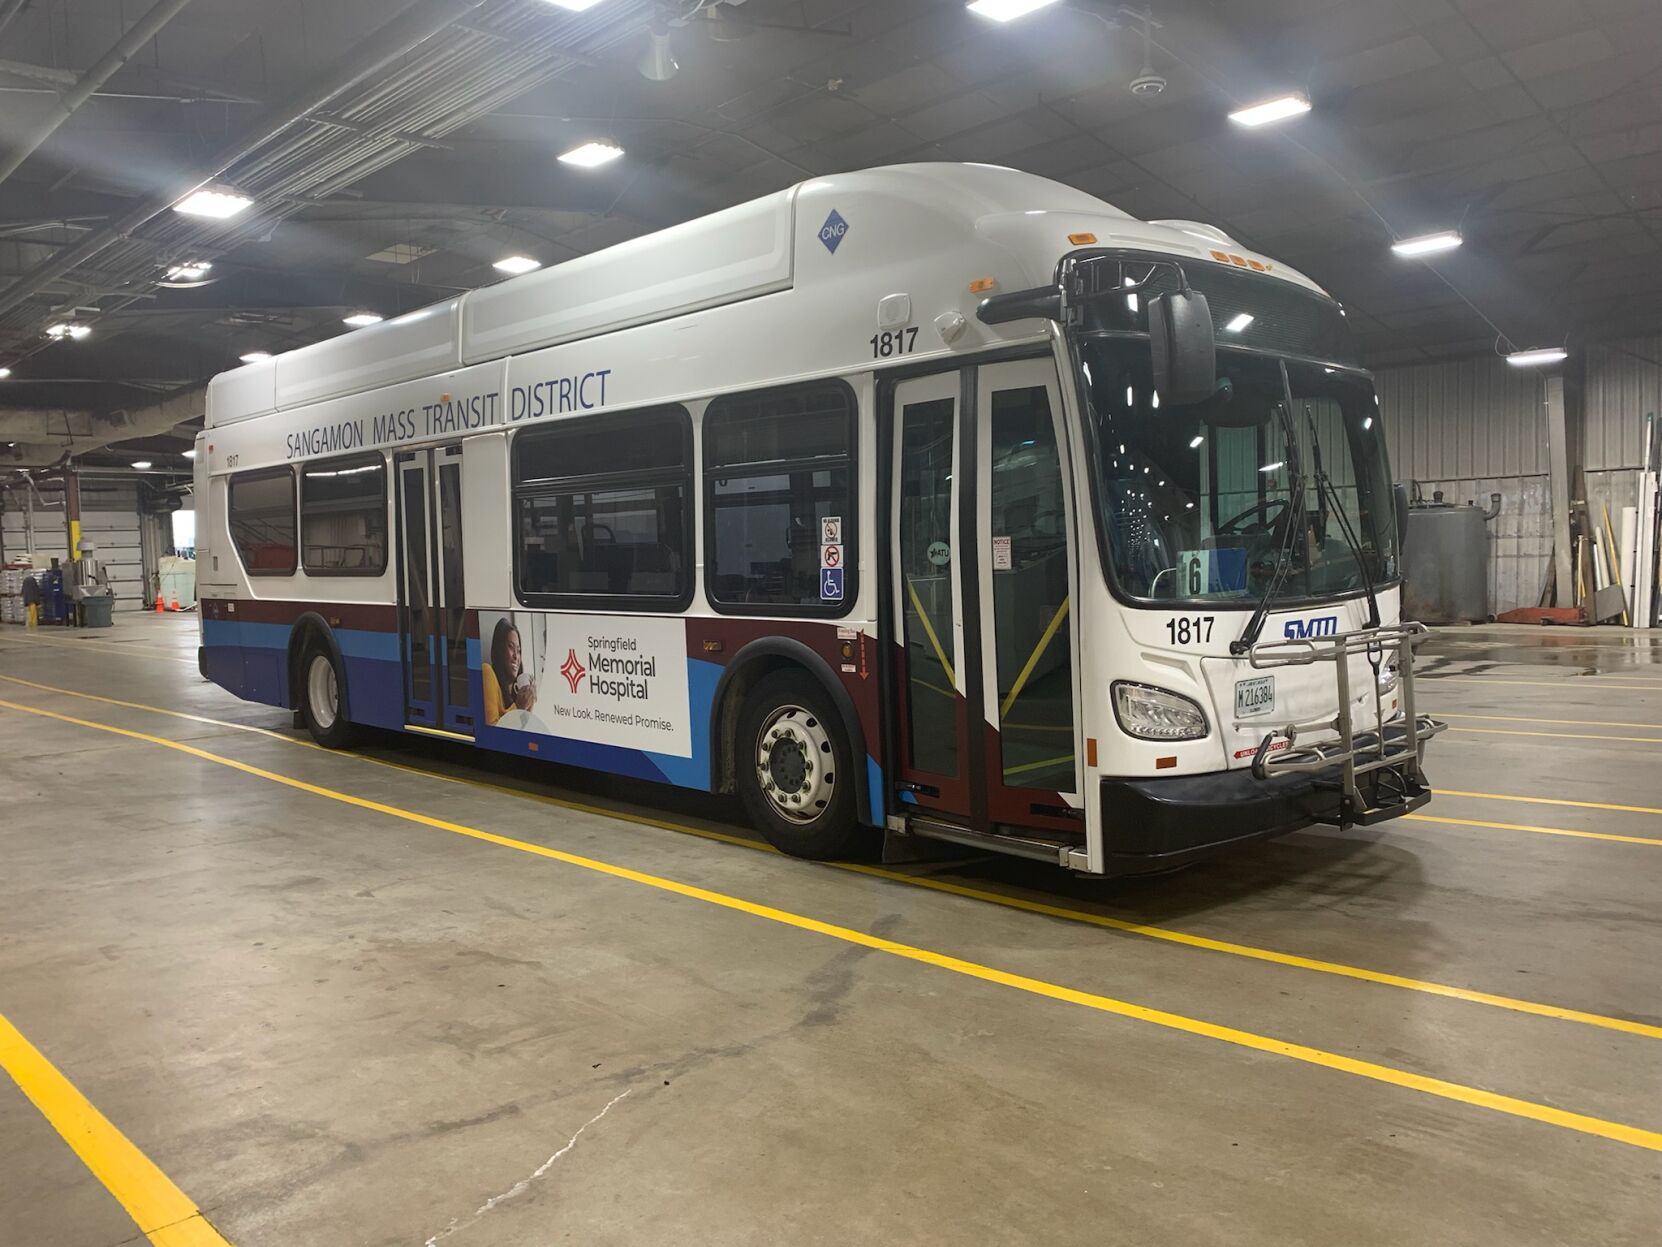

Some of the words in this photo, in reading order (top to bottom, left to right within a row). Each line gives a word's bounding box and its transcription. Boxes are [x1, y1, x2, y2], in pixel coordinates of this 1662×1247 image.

[821, 222, 845, 240] CNG
[870, 326, 919, 358] 1817
[286, 419, 363, 459] SANGAMON
[373, 408, 415, 444] MASS
[423, 393, 499, 436] TRANSIT
[511, 369, 611, 422] DISTRICT
[1189, 558, 1202, 595] 6
[587, 636, 637, 652] Springfield
[1166, 616, 1215, 645] 1817
[588, 652, 656, 678] Memorial
[589, 675, 648, 701] Hospital
[1245, 685, 1273, 707] 216384
[554, 704, 571, 716] New
[572, 706, 592, 720] Look.
[594, 709, 633, 726] Renewed
[635, 715, 674, 732] Promise.
